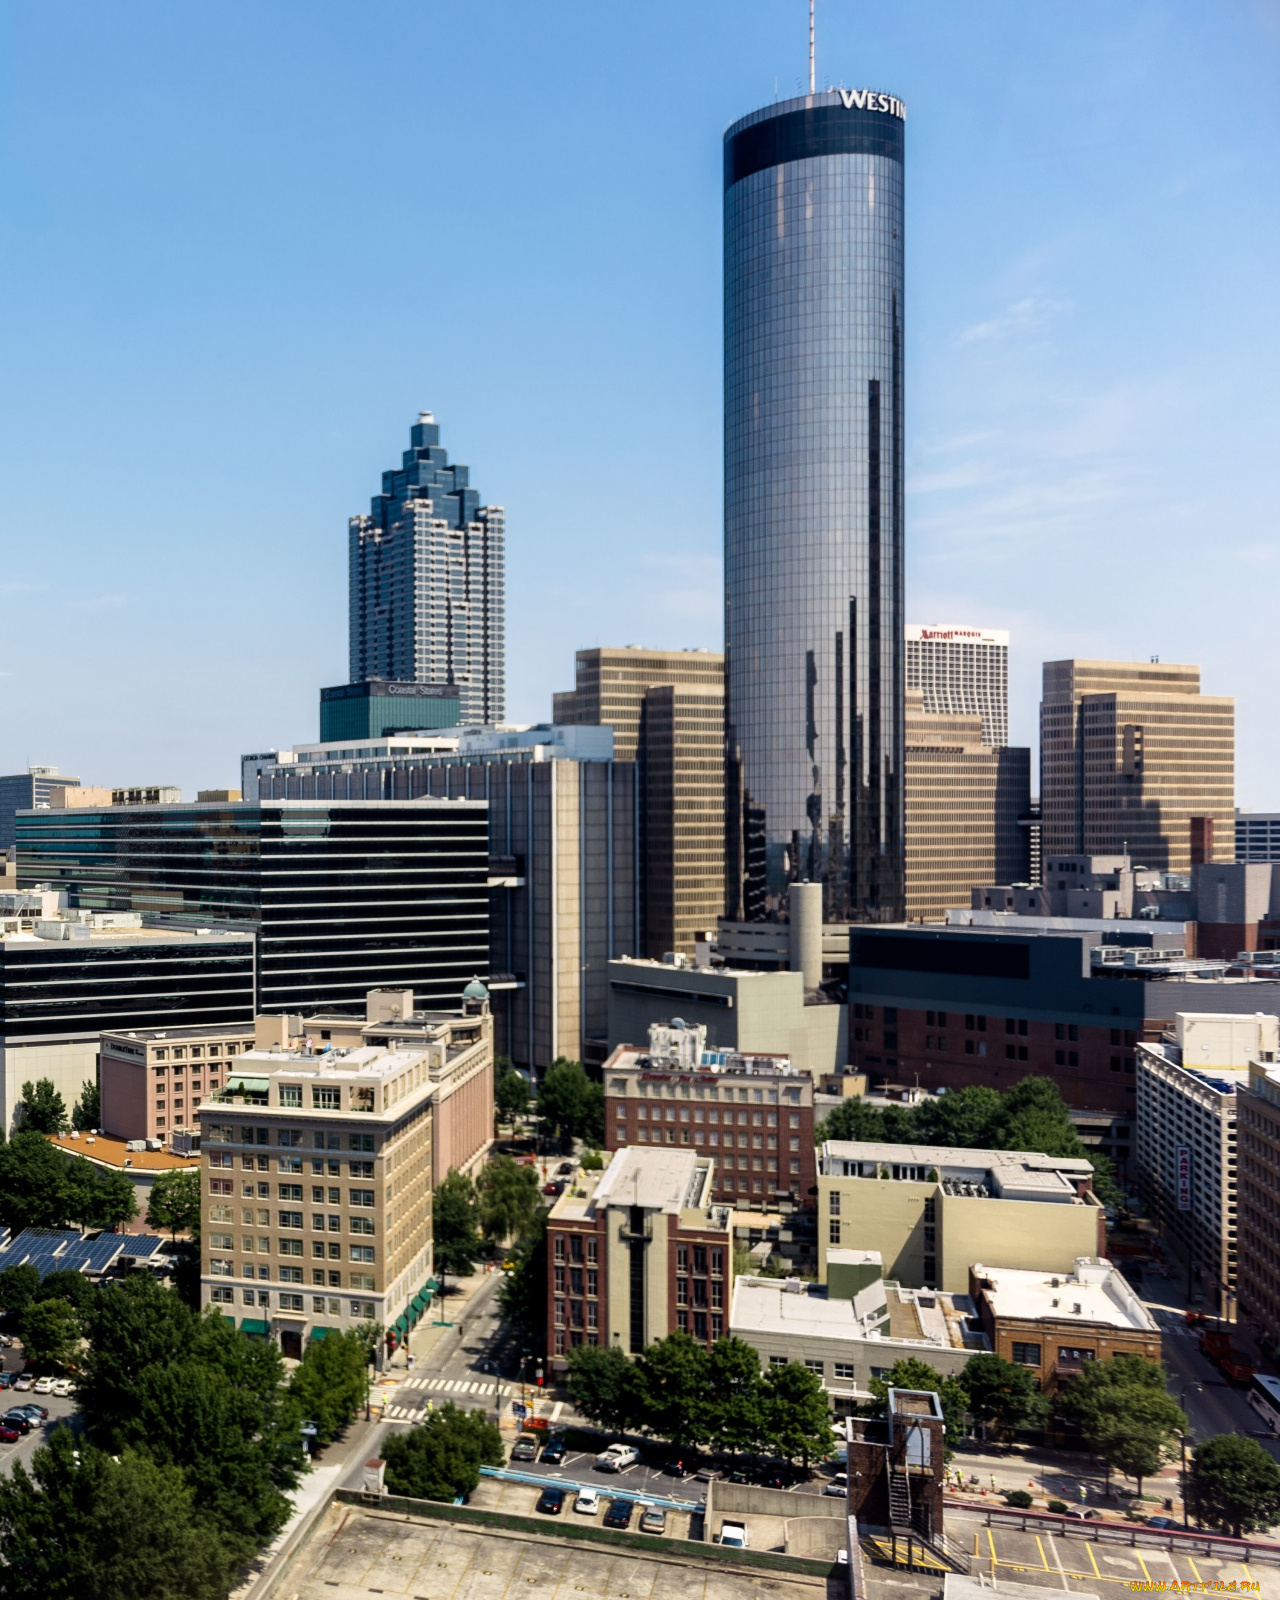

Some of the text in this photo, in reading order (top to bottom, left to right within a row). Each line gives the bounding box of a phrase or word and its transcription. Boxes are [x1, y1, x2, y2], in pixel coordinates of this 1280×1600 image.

[388, 685, 442, 695] Coastal States
[1180, 1149, 1188, 1203] PARKING
[1060, 1349, 1092, 1359] ART
